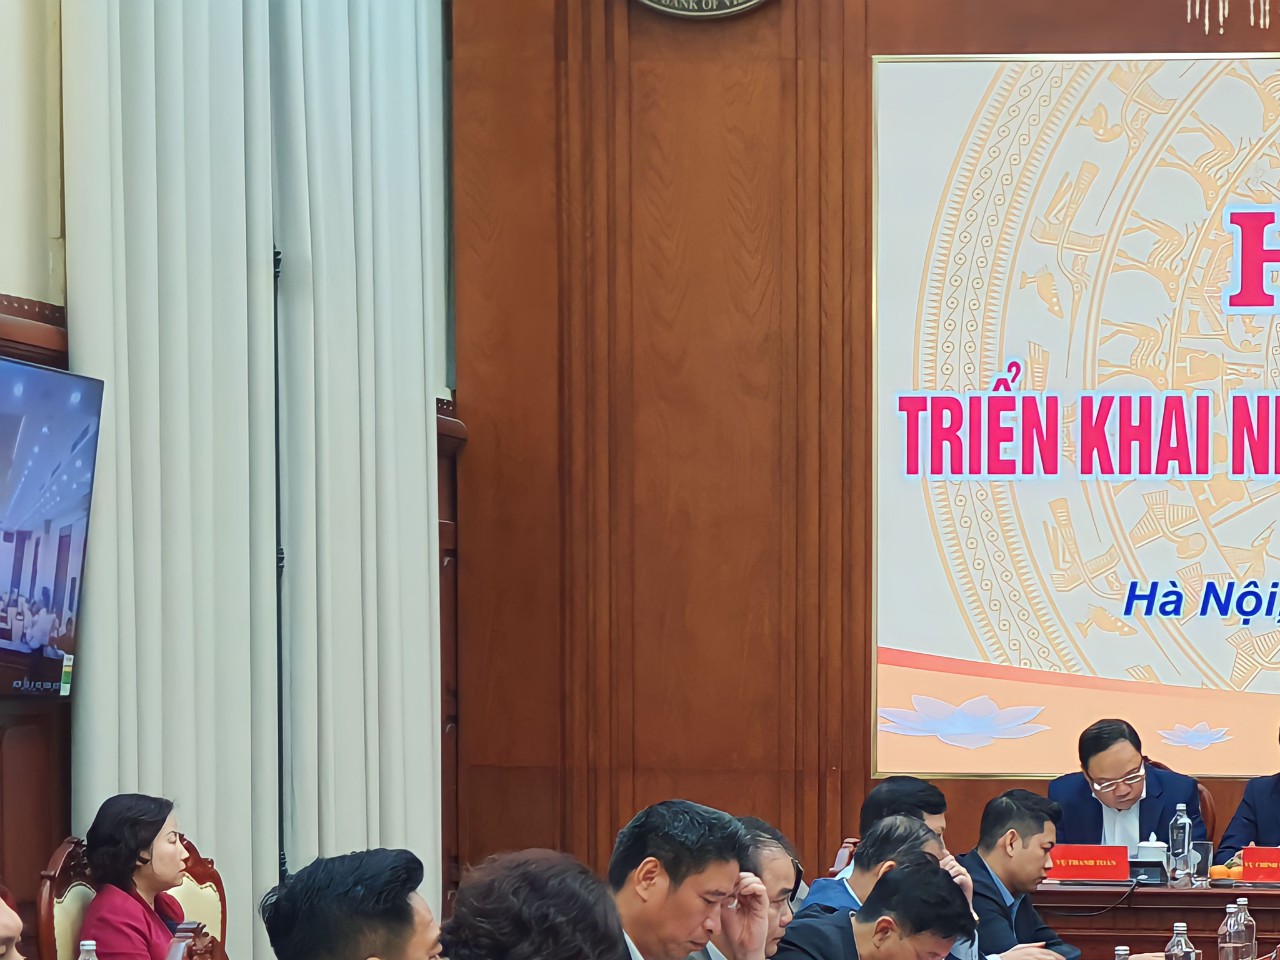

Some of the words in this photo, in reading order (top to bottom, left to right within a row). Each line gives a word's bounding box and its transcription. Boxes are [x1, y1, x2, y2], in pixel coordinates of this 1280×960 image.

[898, 361, 1060, 477] TRIỂN
[1080, 395, 1211, 477] KHAI
[1123, 580, 1185, 618] Hà
